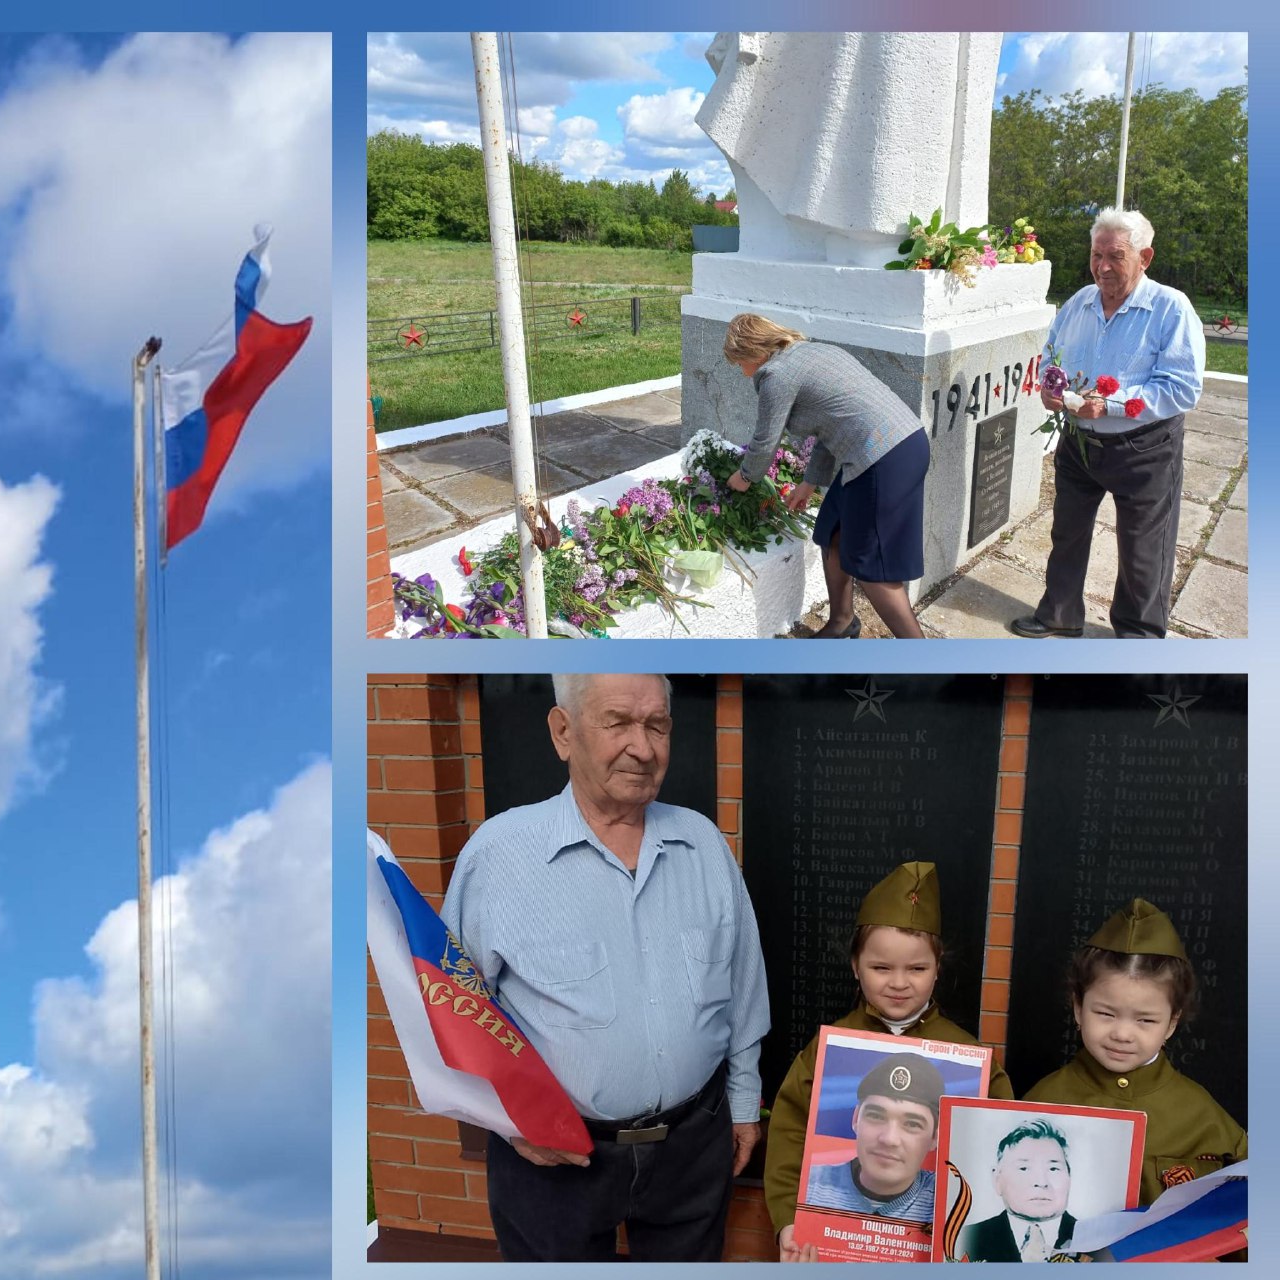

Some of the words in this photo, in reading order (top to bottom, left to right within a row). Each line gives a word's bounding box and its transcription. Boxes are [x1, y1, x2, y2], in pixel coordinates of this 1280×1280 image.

[932, 373, 991, 438] 1941
[796, 728, 808, 741] 1.
[915, 729, 927, 743] К
[794, 744, 807, 757] 2.
[818, 875, 874, 892] Гаврил
[818, 891, 861, 908] Генер
[417, 973, 526, 1058] ОССИЯ
[952, 1046, 987, 1059] России
[824, 1227, 872, 1244] Владимир
[862, 1220, 906, 1236] ТОЩИКОВ
